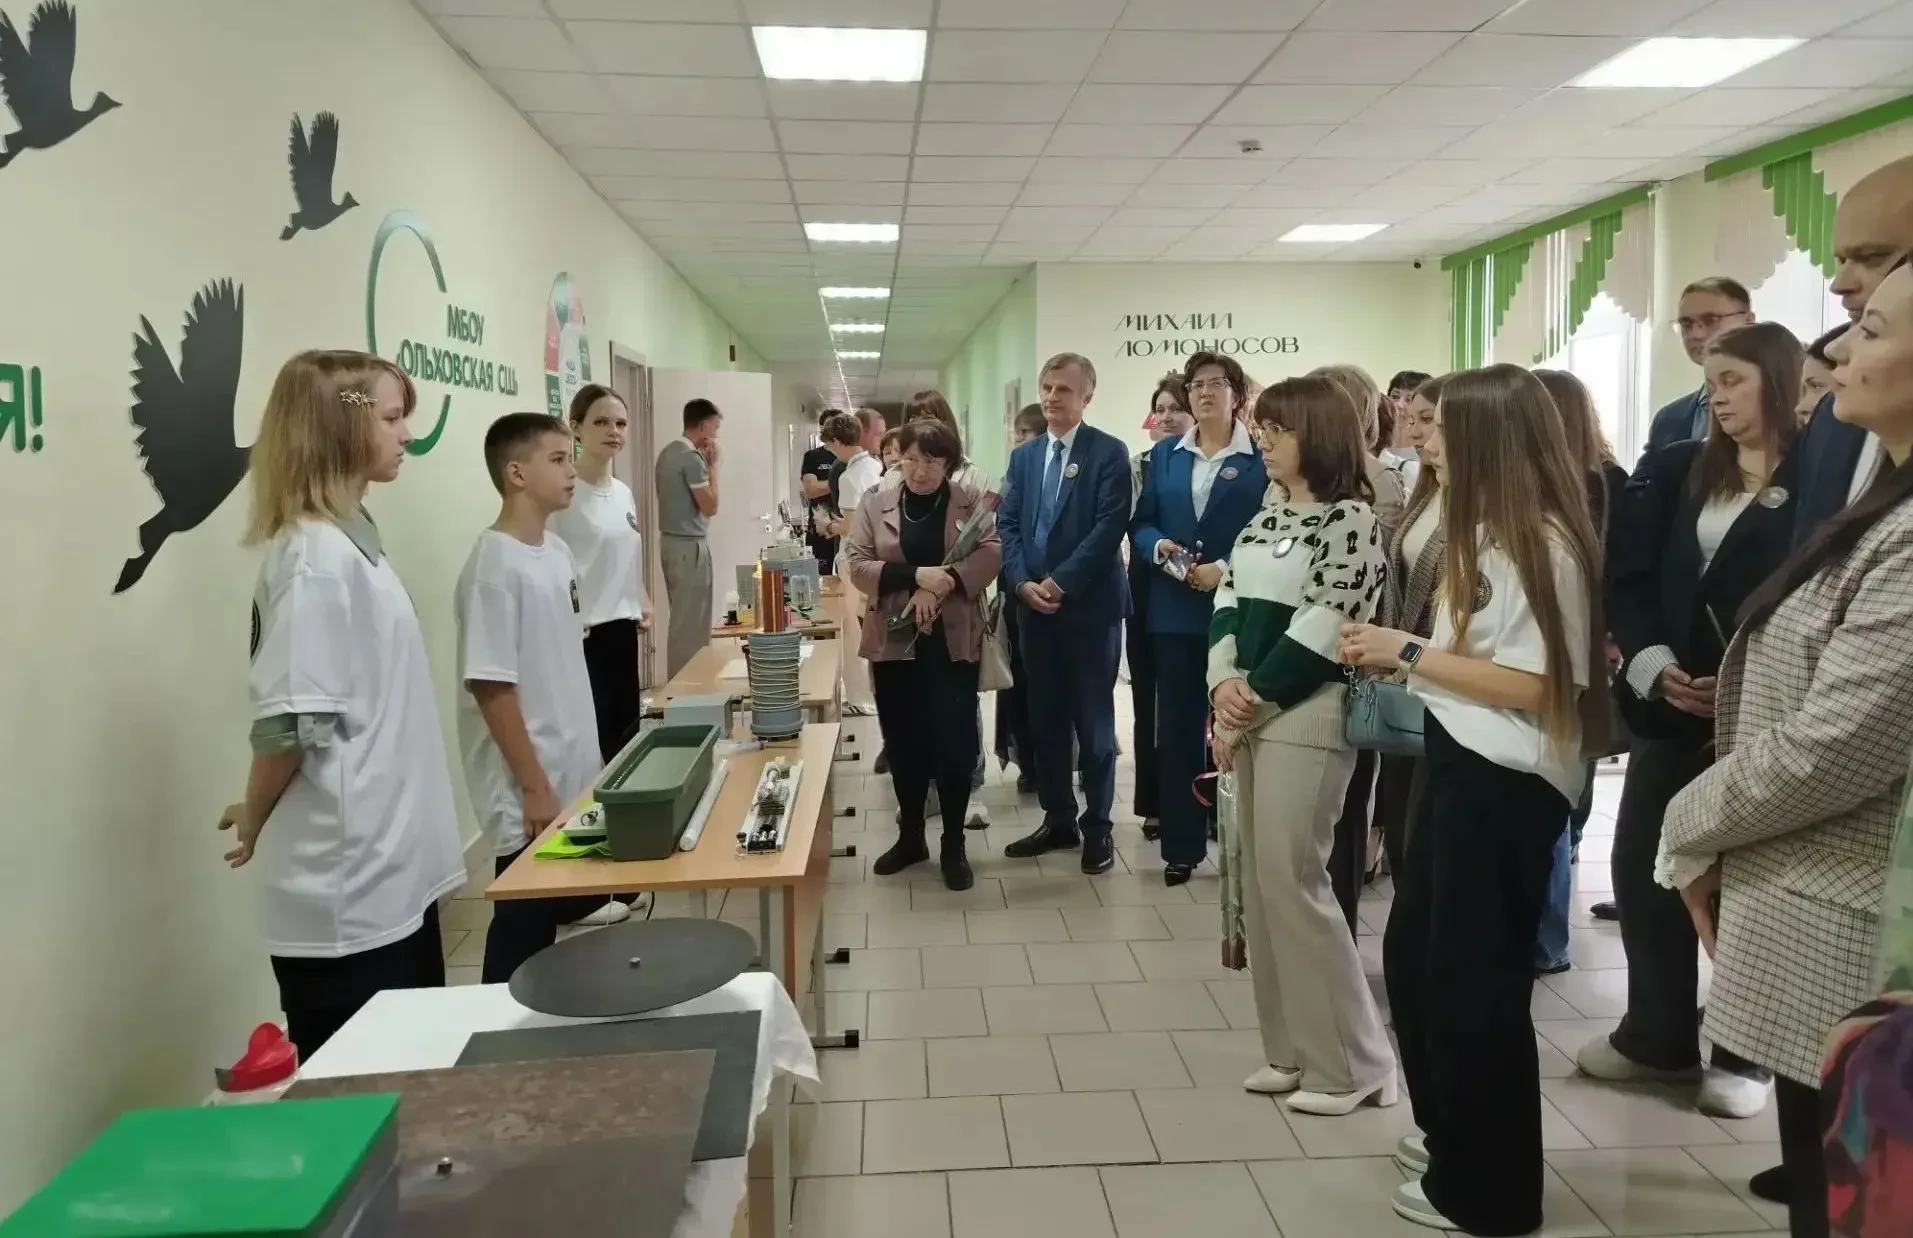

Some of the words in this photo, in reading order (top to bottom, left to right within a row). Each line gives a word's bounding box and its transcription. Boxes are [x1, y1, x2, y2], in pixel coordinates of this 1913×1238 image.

[447, 304, 484, 346] МБОУ
[1114, 312, 1232, 331] МИХАИЛ
[1114, 336, 1299, 358] ЛОМОНОСОВ
